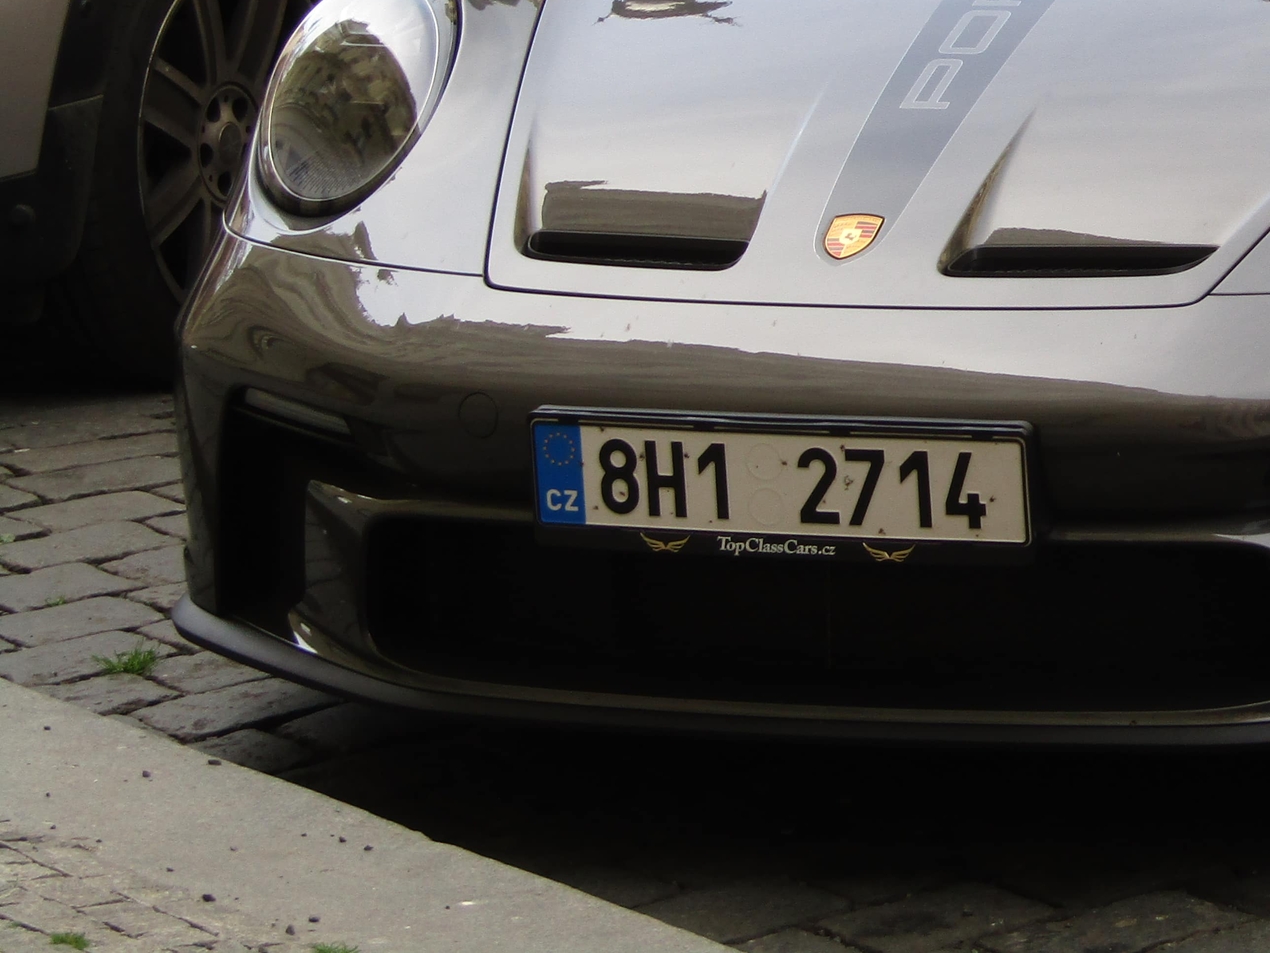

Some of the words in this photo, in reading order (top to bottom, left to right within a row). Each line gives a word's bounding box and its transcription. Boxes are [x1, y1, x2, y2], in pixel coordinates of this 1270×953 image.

[599, 438, 730, 520] 8H1
[797, 447, 987, 530] 2714
[546, 488, 579, 512] CZ
[716, 535, 836, 556] TopClassCars.cz
